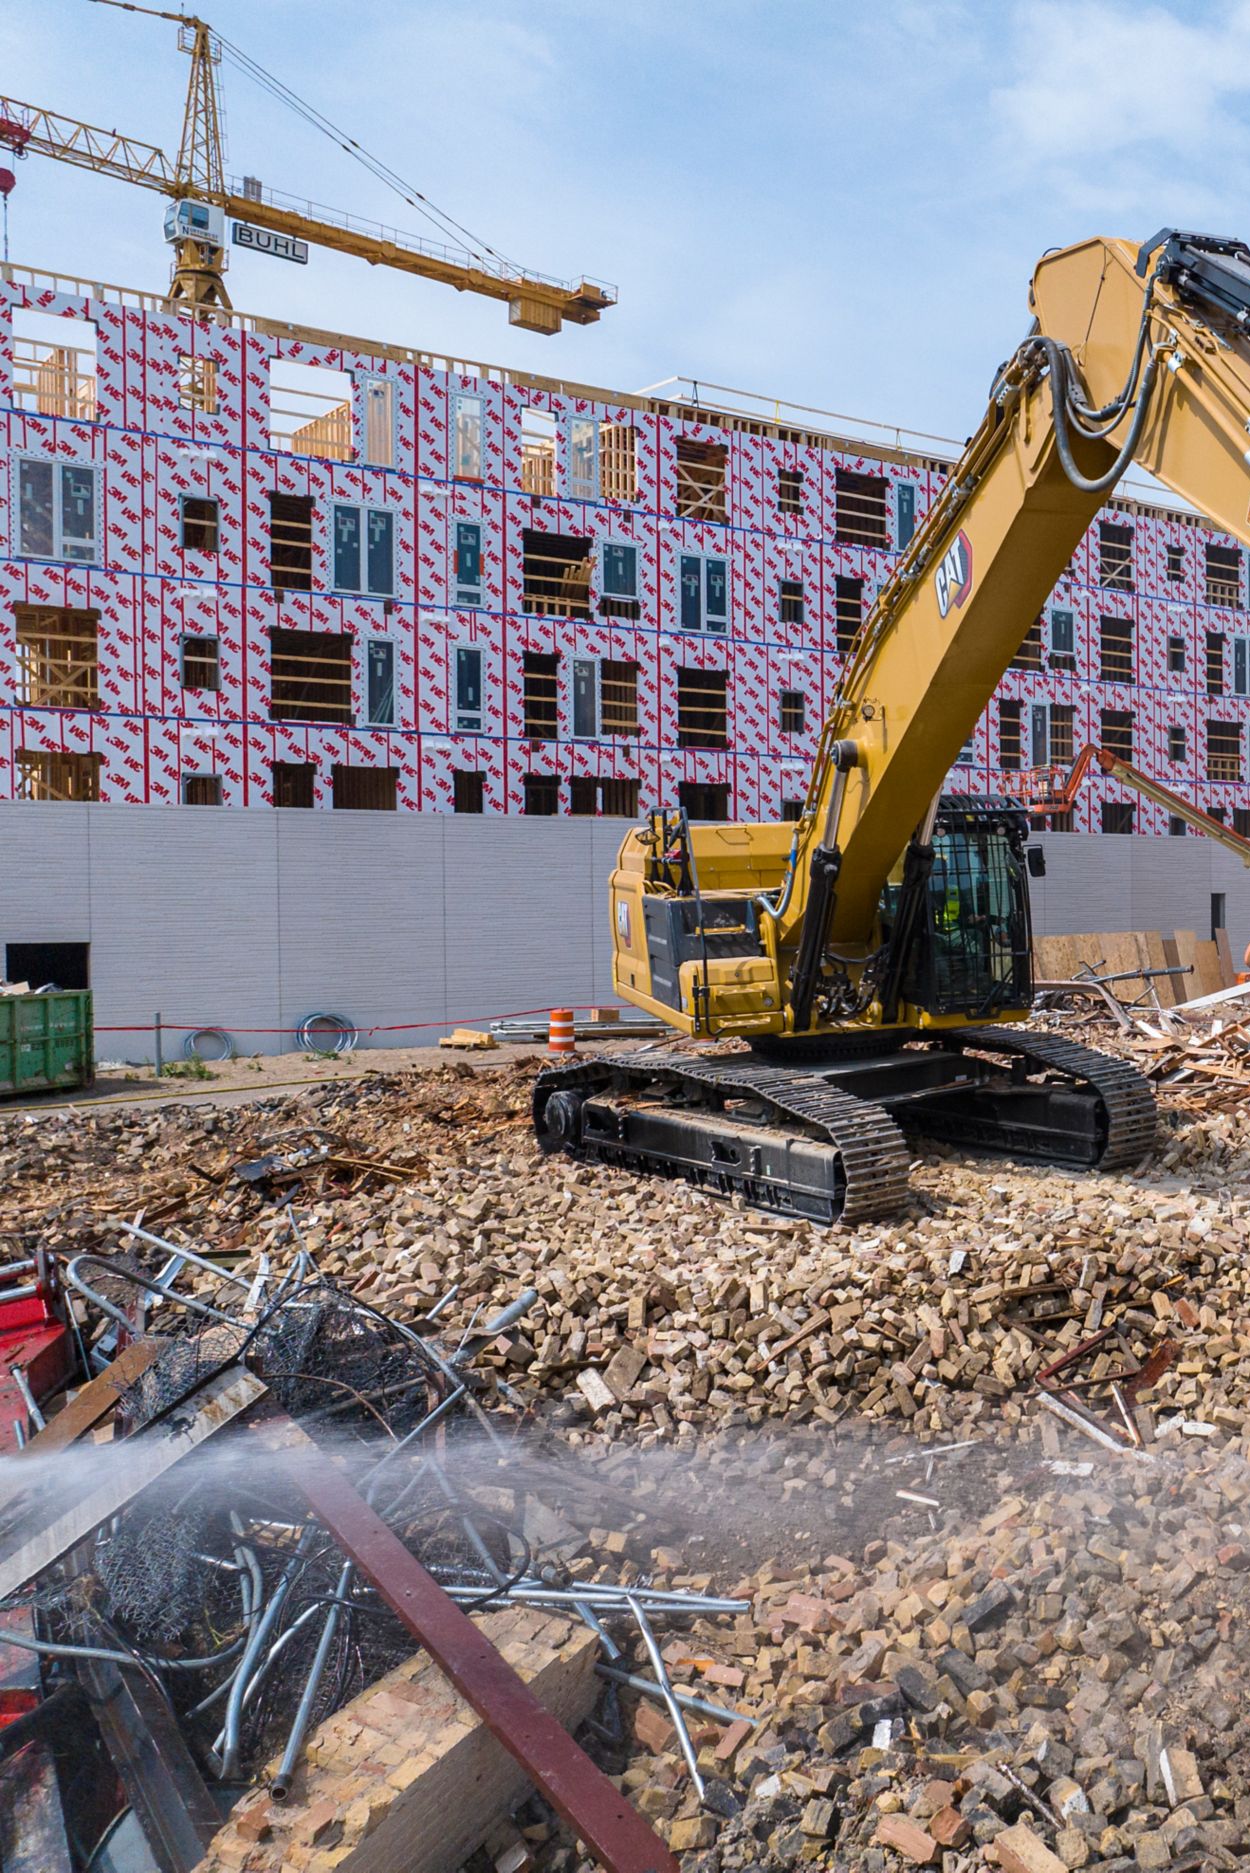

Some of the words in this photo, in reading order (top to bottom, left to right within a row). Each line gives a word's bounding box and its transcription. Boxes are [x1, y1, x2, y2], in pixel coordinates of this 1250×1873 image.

[239, 227, 305, 259] BUHL
[37, 290, 56, 308] 3M
[104, 310, 122, 326] 3M
[222, 335, 241, 351] 3M
[246, 339, 264, 354] 3M
[288, 342, 304, 358] 3M
[103, 347, 122, 362] 3M
[212, 349, 228, 365] 3M
[324, 349, 340, 365] 3M
[222, 370, 241, 386] 3M
[248, 373, 264, 388] 3M
[398, 369, 414, 384] 3M
[103, 384, 124, 401] 3M
[532, 391, 545, 406] 3M
[223, 405, 241, 420] 3M
[247, 408, 264, 423] 3M
[29, 420, 47, 435] 3M
[173, 417, 192, 432] 3M
[643, 415, 656, 427] 3M
[660, 418, 673, 431] 3M
[70, 425, 91, 442] 3M
[212, 422, 228, 436] 3M
[58, 442, 76, 456] 3M
[122, 434, 141, 450] 3M
[487, 443, 501, 455] 3M
[430, 448, 446, 463] 3M
[643, 445, 656, 456] 3M
[660, 448, 673, 461] 3M
[110, 451, 126, 466] 3M
[160, 454, 177, 468] 3M
[259, 454, 275, 470] 3M
[212, 461, 228, 473] 3M
[290, 460, 308, 474] 3M
[418, 464, 434, 478] 3M
[503, 459, 518, 473] 3M
[121, 471, 141, 487] 3M
[172, 473, 188, 488] 3M
[190, 470, 207, 484] 3M
[248, 468, 265, 483] 3M
[277, 475, 295, 489] 3M
[642, 475, 656, 486] 3M
[222, 479, 241, 495] 3M
[660, 478, 674, 490] 3M
[110, 489, 127, 503] 3M
[157, 490, 176, 504] 3M
[388, 488, 402, 501] 3M
[121, 508, 141, 523] 3M
[249, 503, 265, 517] 3M
[429, 507, 444, 521] 3M
[543, 504, 558, 517] 3M
[559, 506, 573, 520] 3M
[223, 514, 239, 528] 3M
[506, 512, 521, 526] 3M
[595, 512, 611, 525] 3M
[108, 524, 127, 539] 3M
[156, 525, 177, 539] 3M
[418, 521, 434, 535] 3M
[643, 522, 656, 536] 3M
[703, 526, 716, 541] 3M
[823, 524, 835, 535] 3M
[669, 528, 684, 543] 3M
[121, 544, 141, 561] 3M
[248, 538, 265, 553] 3M
[430, 540, 444, 553] 3M
[506, 545, 522, 557] 3M
[660, 541, 672, 552] 3M
[224, 550, 241, 564] 3M
[418, 554, 434, 568] 3M
[487, 551, 502, 564] 3M
[643, 553, 656, 565] 3M
[764, 559, 777, 569] 3M
[822, 557, 835, 568] 3M
[4, 564, 25, 580] 3M
[43, 568, 64, 583] 3M
[157, 561, 176, 576] 3M
[184, 563, 203, 577] 3M
[249, 574, 265, 587] 3M
[506, 577, 522, 590] 3M
[660, 571, 674, 583] 3M
[935, 536, 964, 617] CAT
[28, 585, 49, 600] 3M
[418, 587, 435, 600] 3M
[487, 583, 502, 597] 3M
[644, 583, 656, 595] 3M
[808, 581, 820, 592] 3M
[89, 586, 110, 603] 3M
[751, 594, 764, 609] 3M
[197, 602, 216, 617] 3M
[292, 599, 309, 613] 3M
[323, 596, 341, 609] 3M
[222, 603, 241, 617] 3M
[247, 607, 265, 622] 3M
[355, 605, 371, 620] 3M
[184, 619, 204, 633] 3M
[280, 615, 298, 630] 3M
[397, 617, 413, 631] 3M
[506, 618, 522, 631] 3M
[762, 615, 777, 626] 3M
[476, 624, 491, 637] 3M
[223, 637, 241, 653] 3M
[418, 634, 435, 648] 3M
[247, 642, 265, 657] 3M
[506, 650, 522, 663] 3M
[430, 652, 445, 666] 3M
[744, 659, 758, 670] 3M
[768, 661, 781, 672] 3M
[224, 673, 241, 687] 3M
[418, 667, 435, 681] 3M
[487, 672, 502, 686] 3M
[660, 675, 674, 687] 3M
[755, 674, 766, 686] 3M
[247, 677, 266, 691] 3M
[506, 681, 522, 694] 3M
[198, 702, 216, 716] 3M
[488, 706, 502, 718] 3M
[24, 717, 45, 732] 3M
[507, 713, 522, 726] 3M
[69, 725, 90, 744] 3M
[124, 720, 143, 736] 3M
[275, 727, 293, 739] 3M
[39, 736, 61, 753] 3M
[112, 738, 130, 753] 3M
[194, 737, 212, 752] 3M
[224, 733, 240, 747] 3M
[248, 737, 266, 752] 3M
[150, 747, 168, 761] 3M
[288, 743, 304, 757] 3M
[323, 744, 340, 757] 3M
[124, 756, 143, 772] 3M
[180, 755, 200, 770] 3M
[507, 759, 522, 772] 3M
[671, 756, 684, 768] 3M
[696, 758, 708, 770] 3M
[736, 761, 750, 773] 3M
[224, 768, 241, 781] 3M
[400, 764, 417, 776] 3M
[488, 766, 503, 778] 3M
[661, 770, 676, 782] 3M
[758, 765, 772, 776] 3M
[111, 775, 130, 789] 3M
[250, 773, 266, 787] 3M
[768, 780, 780, 791] 3M
[150, 783, 170, 797] 3M
[737, 790, 749, 801] 3M
[401, 797, 417, 810] 3M
[508, 791, 523, 804] 3M
